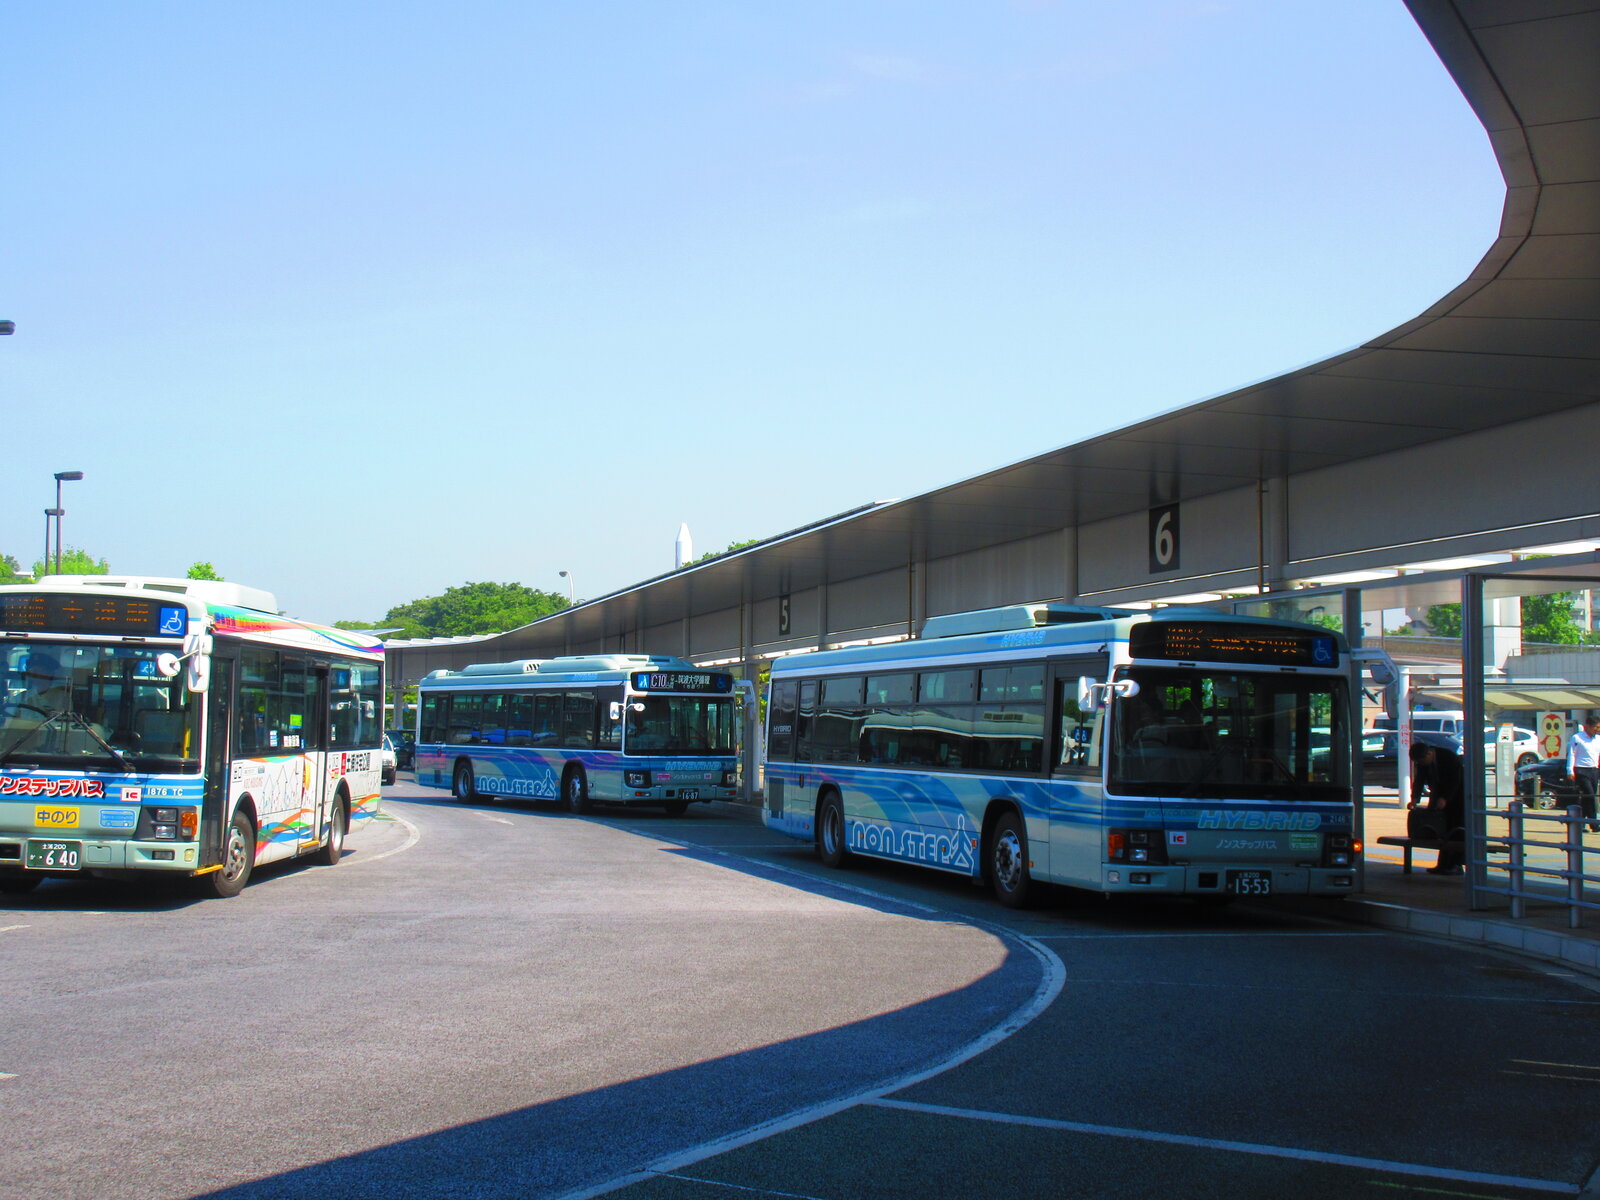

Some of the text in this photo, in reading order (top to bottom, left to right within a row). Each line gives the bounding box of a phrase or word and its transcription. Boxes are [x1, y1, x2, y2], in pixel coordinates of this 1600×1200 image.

[1155, 511, 1174, 565] 6
[781, 599, 789, 631] 5
[651, 675, 666, 688] C10
[773, 725, 792, 733] HYBRID
[147, 787, 183, 796] 1876 TC
[37, 810, 77, 824] 中のり
[1197, 810, 1322, 831] HYBRID
[1216, 839, 1277, 849] ノンステップバス
[1235, 879, 1270, 894] 15-53
